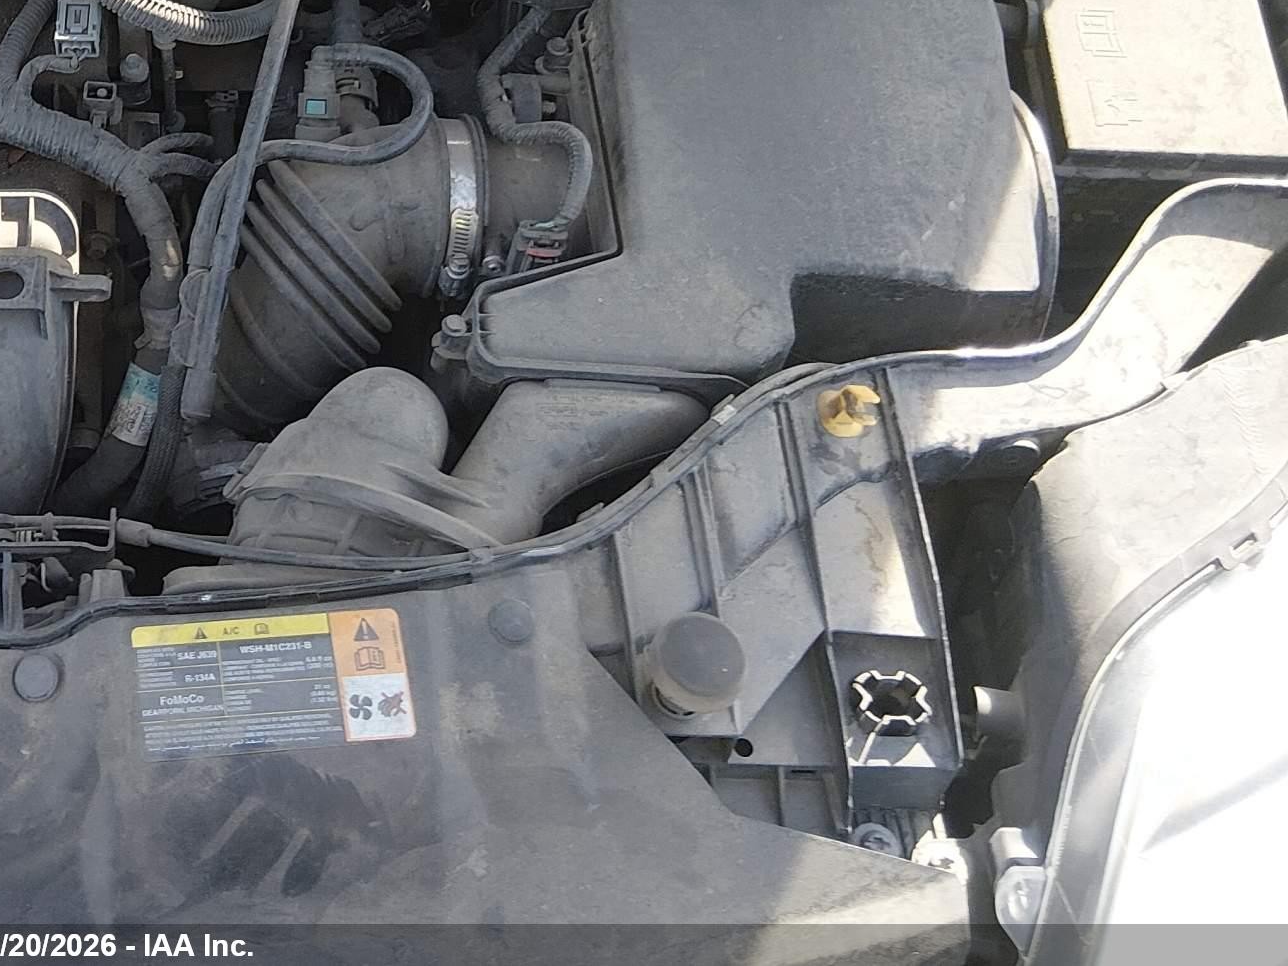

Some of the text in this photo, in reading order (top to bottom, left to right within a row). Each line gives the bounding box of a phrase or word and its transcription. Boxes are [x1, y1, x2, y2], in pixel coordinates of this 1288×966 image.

[223, 626, 240, 635] A/C
[177, 651, 196, 660] SAE
[239, 641, 312, 653] WSH-M1C231-B
[184, 673, 216, 683] R-134A
[159, 693, 205, 706] FoMoCo
